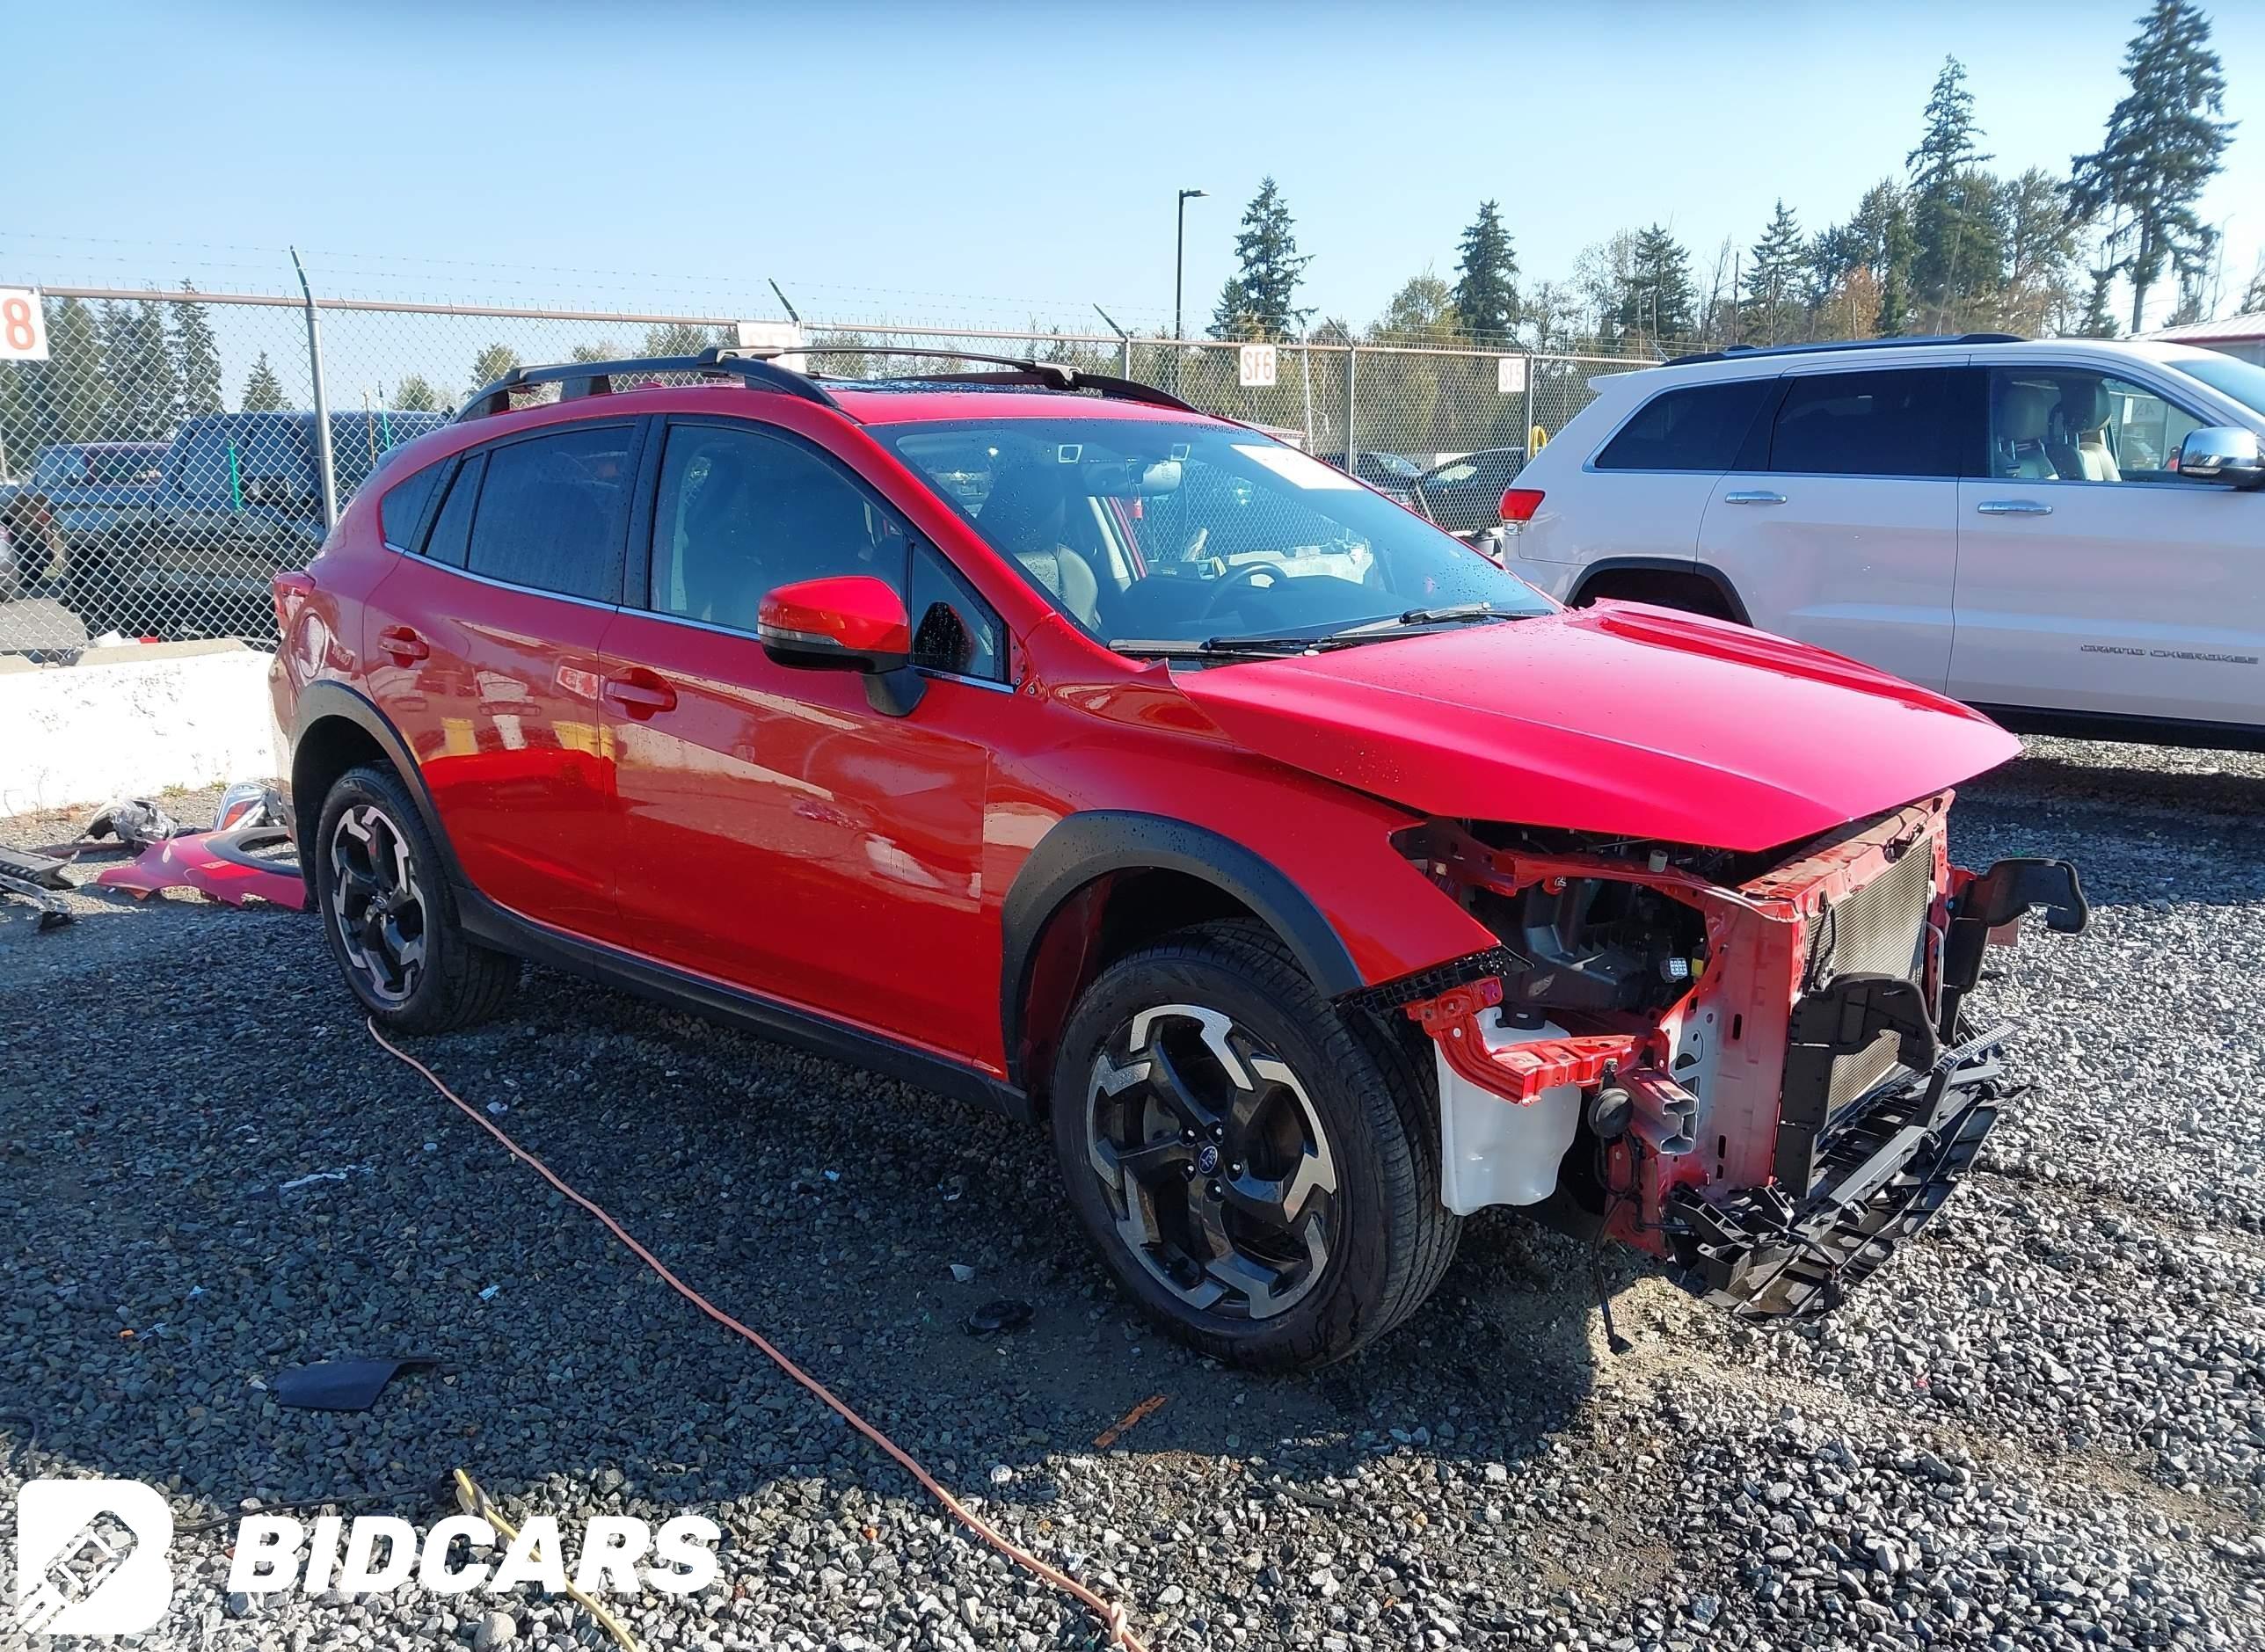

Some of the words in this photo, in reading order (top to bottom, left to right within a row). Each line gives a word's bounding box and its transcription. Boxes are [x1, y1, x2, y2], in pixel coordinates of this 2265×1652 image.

[1244, 352, 1272, 380] SF6
[1501, 363, 1522, 387] SF5
[2080, 644, 2145, 656] GRAND
[2150, 650, 2259, 665] CHEROKEE
